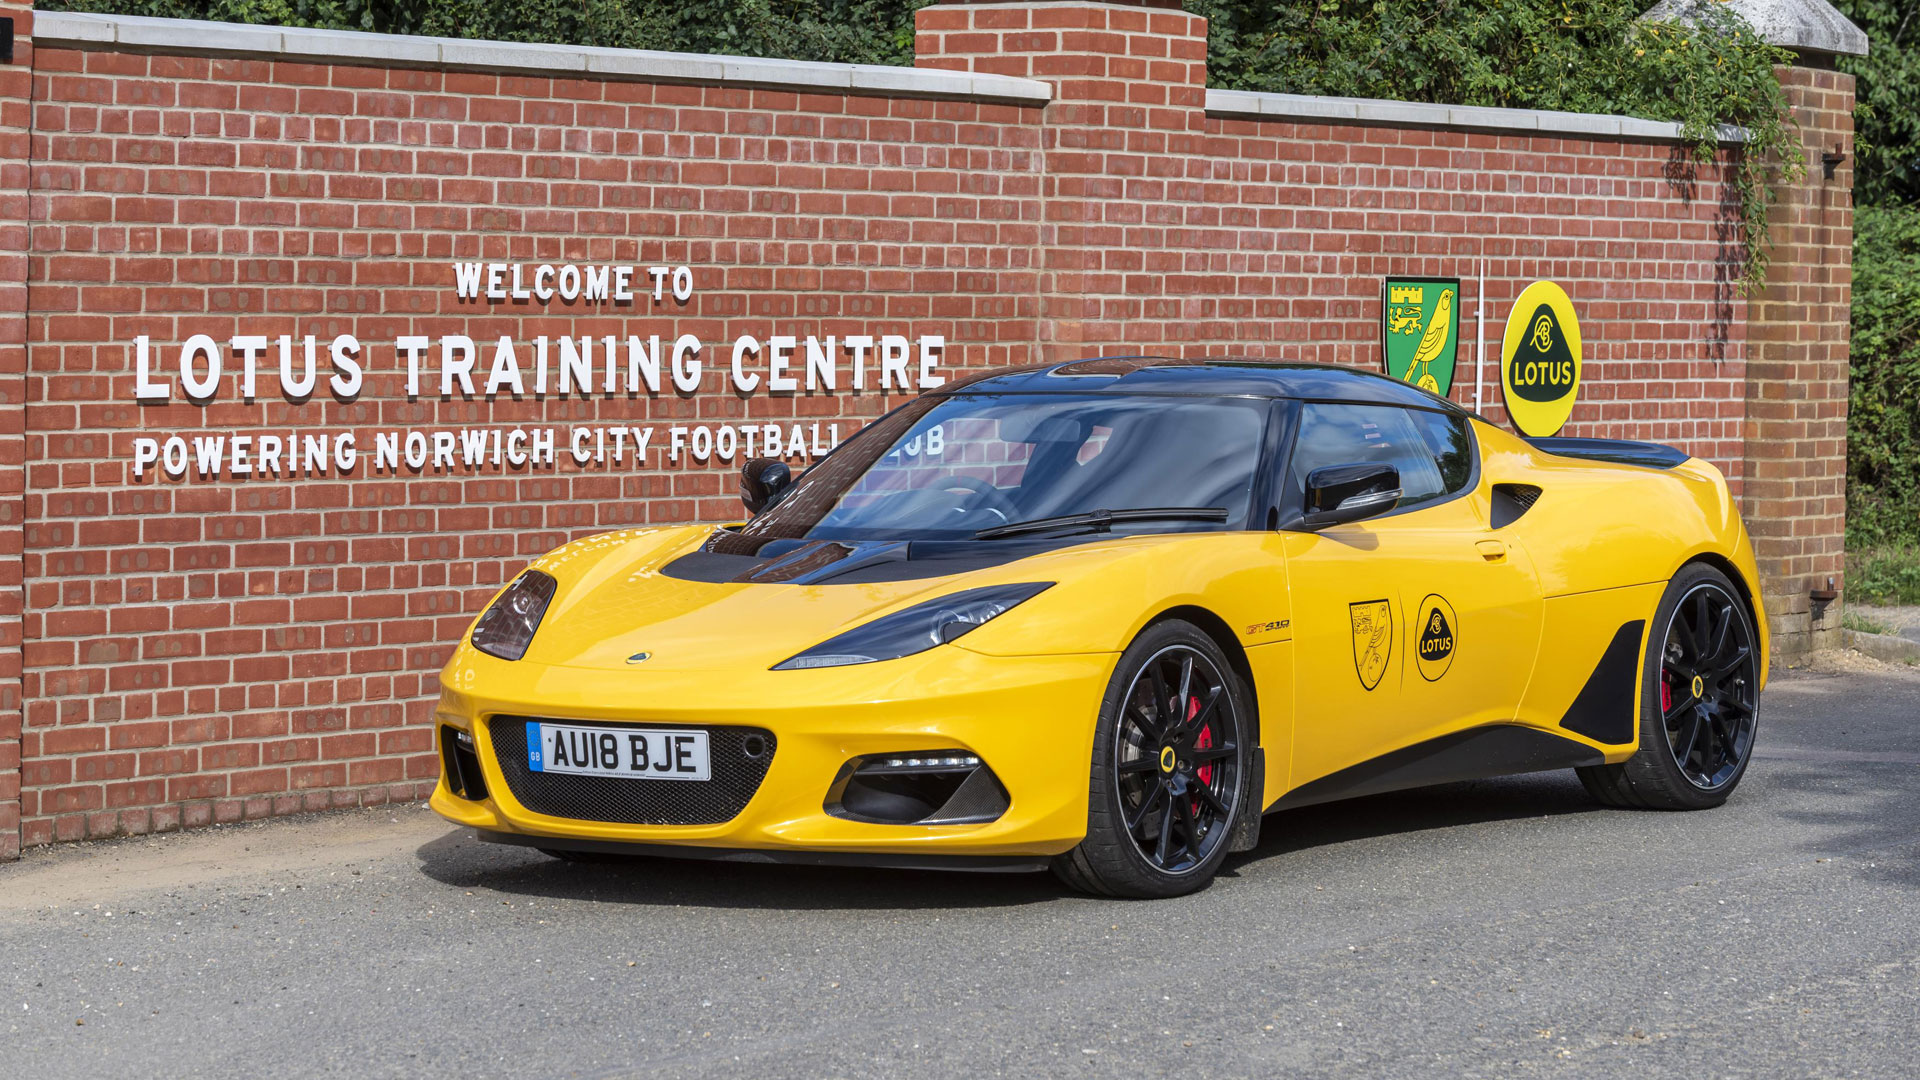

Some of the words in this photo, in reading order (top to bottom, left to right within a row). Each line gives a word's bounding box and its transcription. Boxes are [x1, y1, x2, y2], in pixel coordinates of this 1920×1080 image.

[455, 262, 634, 300] WELCOME
[647, 265, 693, 301] TO
[133, 334, 363, 399] LOTUS
[396, 334, 702, 396] TRAINING
[731, 334, 946, 392] CENTRE
[1514, 361, 1572, 386] LOTUS
[134, 434, 357, 476] POWERING
[376, 429, 554, 469] NORWICH
[572, 427, 654, 463] CITY
[668, 423, 838, 461] FOOTBALL
[1421, 636, 1452, 654] LOTUS
[530, 751, 541, 762] GB
[553, 730, 619, 770] AU18
[628, 734, 697, 773] BJE
